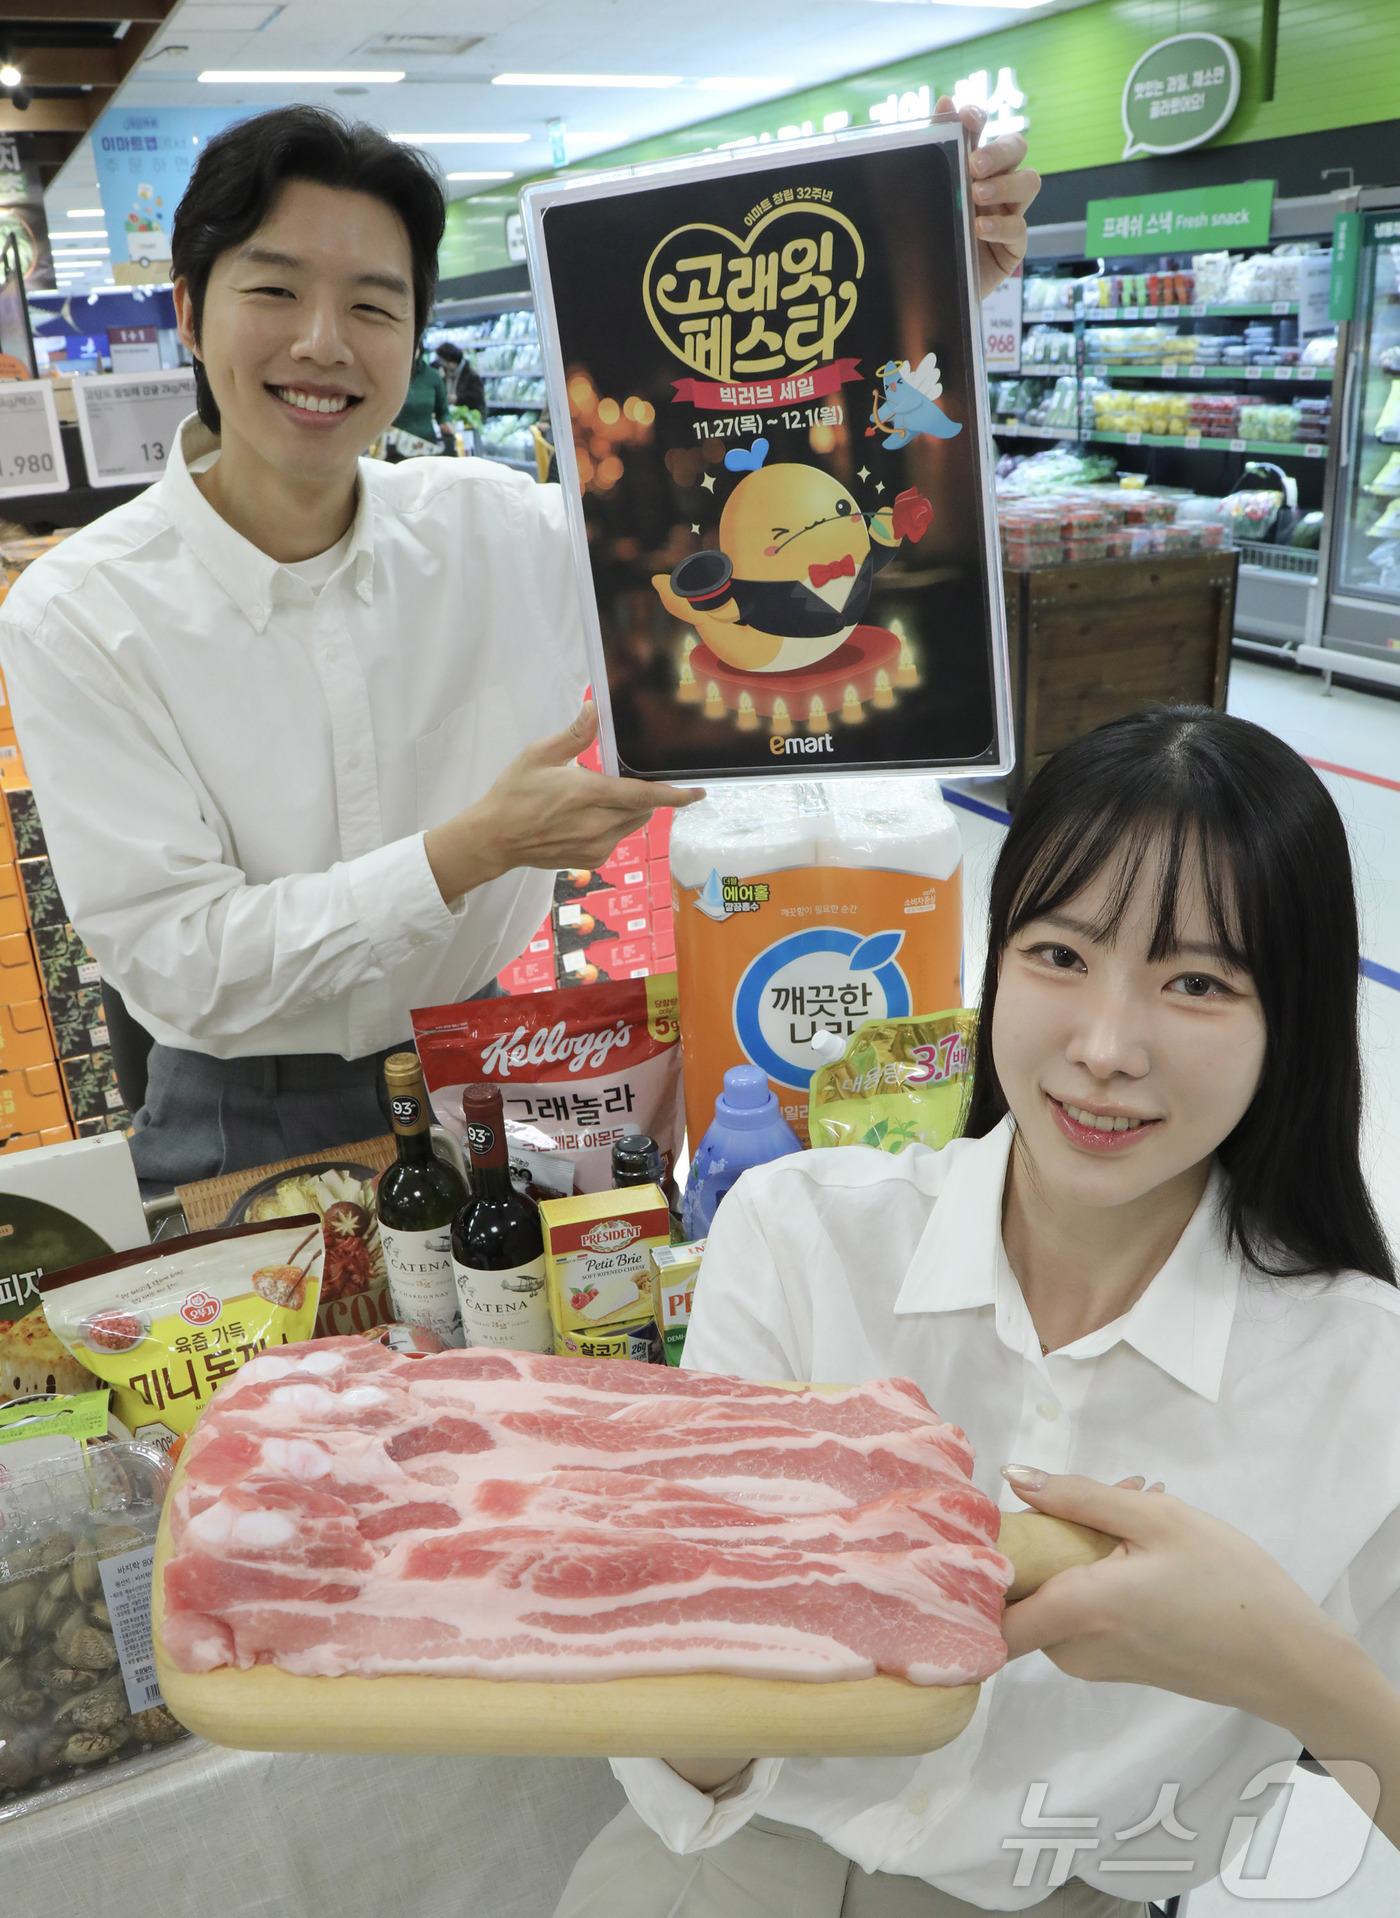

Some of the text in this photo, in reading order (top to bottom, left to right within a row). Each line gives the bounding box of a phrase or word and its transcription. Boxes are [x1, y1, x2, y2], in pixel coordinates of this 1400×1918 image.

[743, 186, 834, 227] 이마트 창립 32주년
[1102, 208, 1249, 239] 프레쉬 스낵 Fresh snack
[656, 230, 834, 316] 고래잇
[119, 329, 146, 342] 1+1
[678, 281, 857, 381] 페스타
[719, 375, 815, 406] 빅러브 세일
[692, 414, 763, 440] 11.27(목)
[781, 405, 844, 430] 12.1(월)
[769, 733, 834, 755] emart
[722, 877, 738, 885] 더블
[723, 885, 769, 902] 에어홀
[724, 902, 760, 912] 깔끔흡수
[781, 904, 858, 918] 깨끗함이 필요한 순간
[771, 982, 872, 1018] 깨끗한
[655, 1016, 679, 1035] 5g
[480, 1020, 633, 1077] Kellogg's
[392, 1101, 413, 1115] 93
[506, 1083, 635, 1127] 그래놀라
[468, 1126, 486, 1143] 93
[583, 1128, 625, 1148] 아몬드
[391, 1259, 451, 1273] CATENA
[585, 1253, 642, 1272] Petit Brie
[190, 1306, 215, 1321] 오뚜기
[465, 1298, 528, 1313] CATENA
[175, 1321, 245, 1354] 육즙 가득
[580, 1341, 627, 1357] 살코기
[117, 1560, 140, 1574] 바지락
